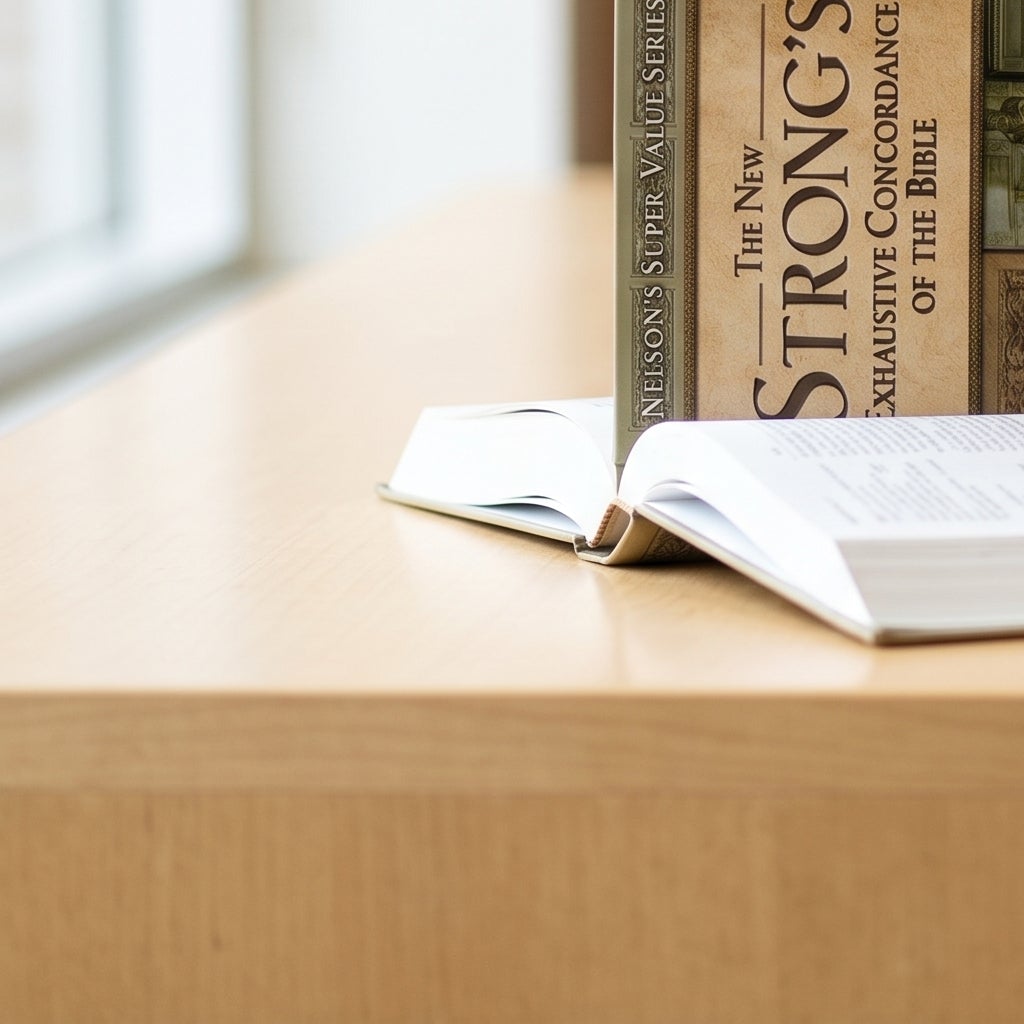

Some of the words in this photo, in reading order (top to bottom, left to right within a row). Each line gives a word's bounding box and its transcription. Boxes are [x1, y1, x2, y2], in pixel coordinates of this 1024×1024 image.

[640, 91, 665, 179] VALUE
[865, 1, 899, 238] CONCORDANCE
[906, 118, 937, 199] BIBLE
[734, 144, 764, 213] NEW
[641, 191, 664, 275] SUPER
[734, 222, 763, 277] THE
[912, 209, 937, 262] THE
[912, 275, 937, 314] OF
[641, 285, 664, 419] NELSON'S
